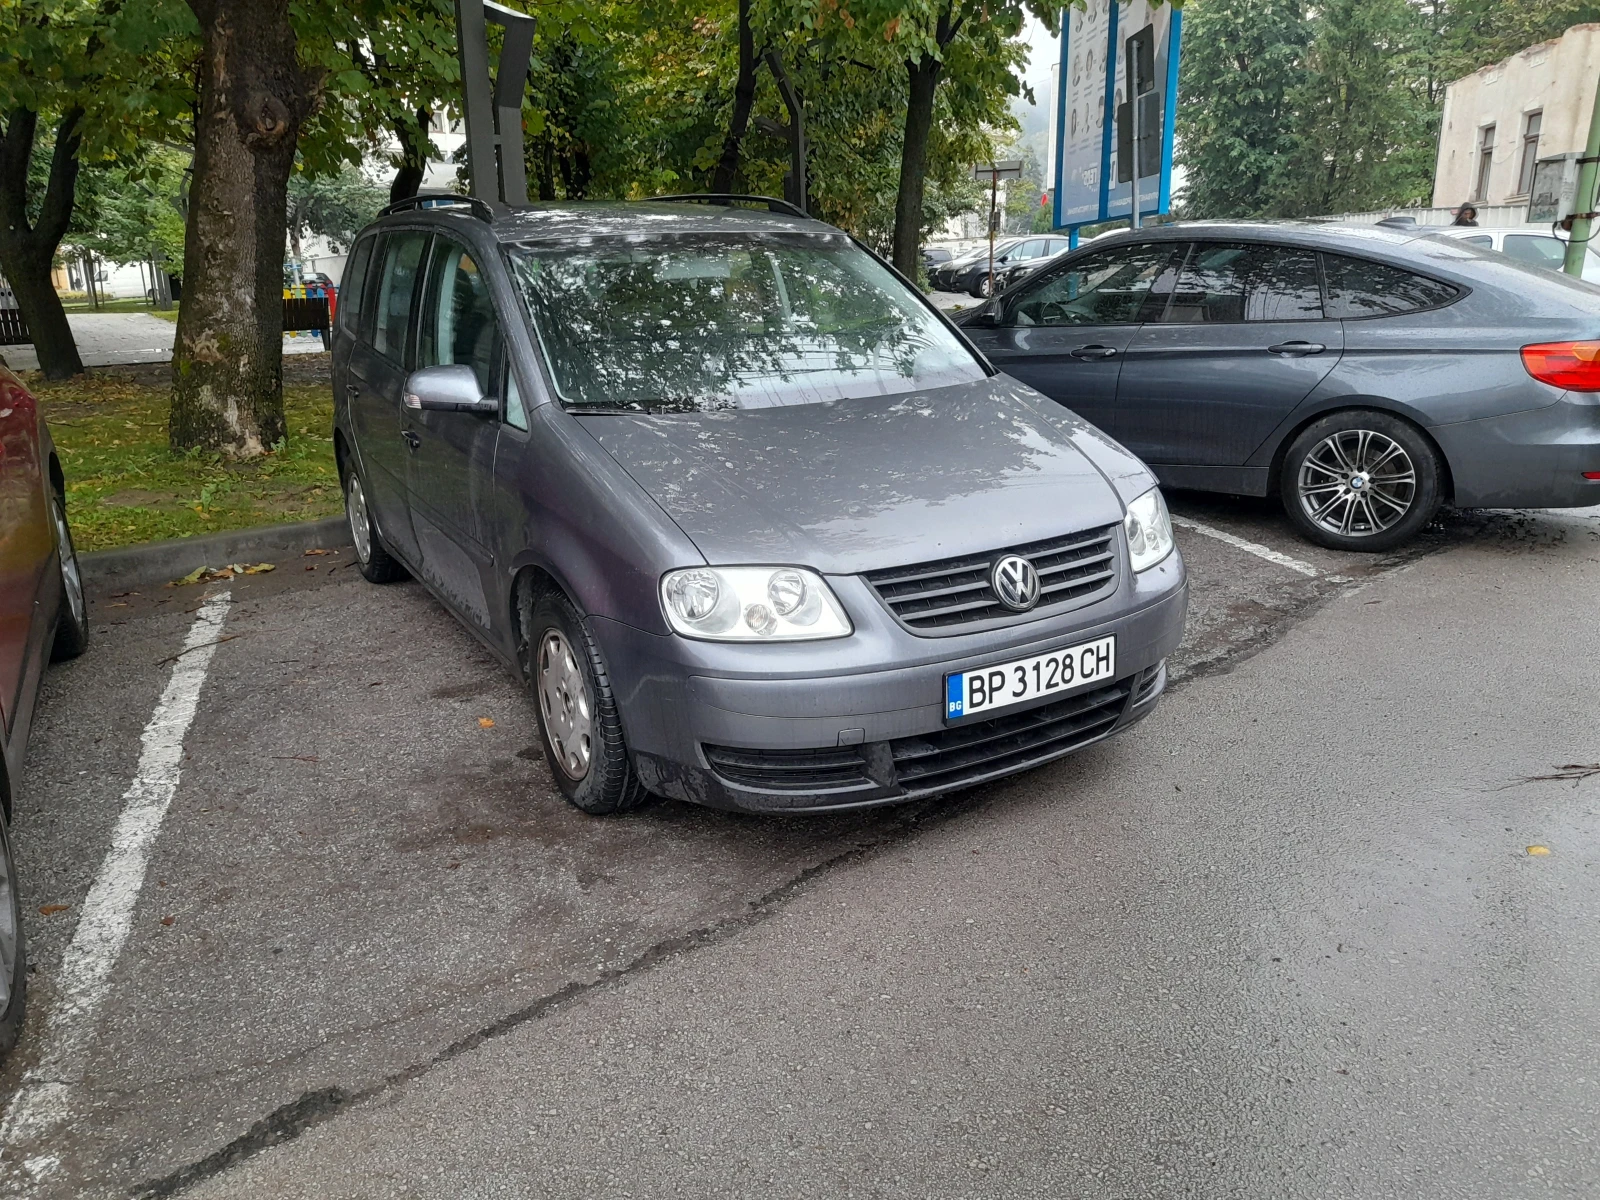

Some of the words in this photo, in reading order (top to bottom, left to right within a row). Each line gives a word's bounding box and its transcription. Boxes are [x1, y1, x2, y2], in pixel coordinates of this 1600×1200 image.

[968, 670, 1006, 709] BP
[1012, 653, 1075, 698] 3128
[1080, 642, 1110, 679] CH
[949, 701, 962, 712] BG
